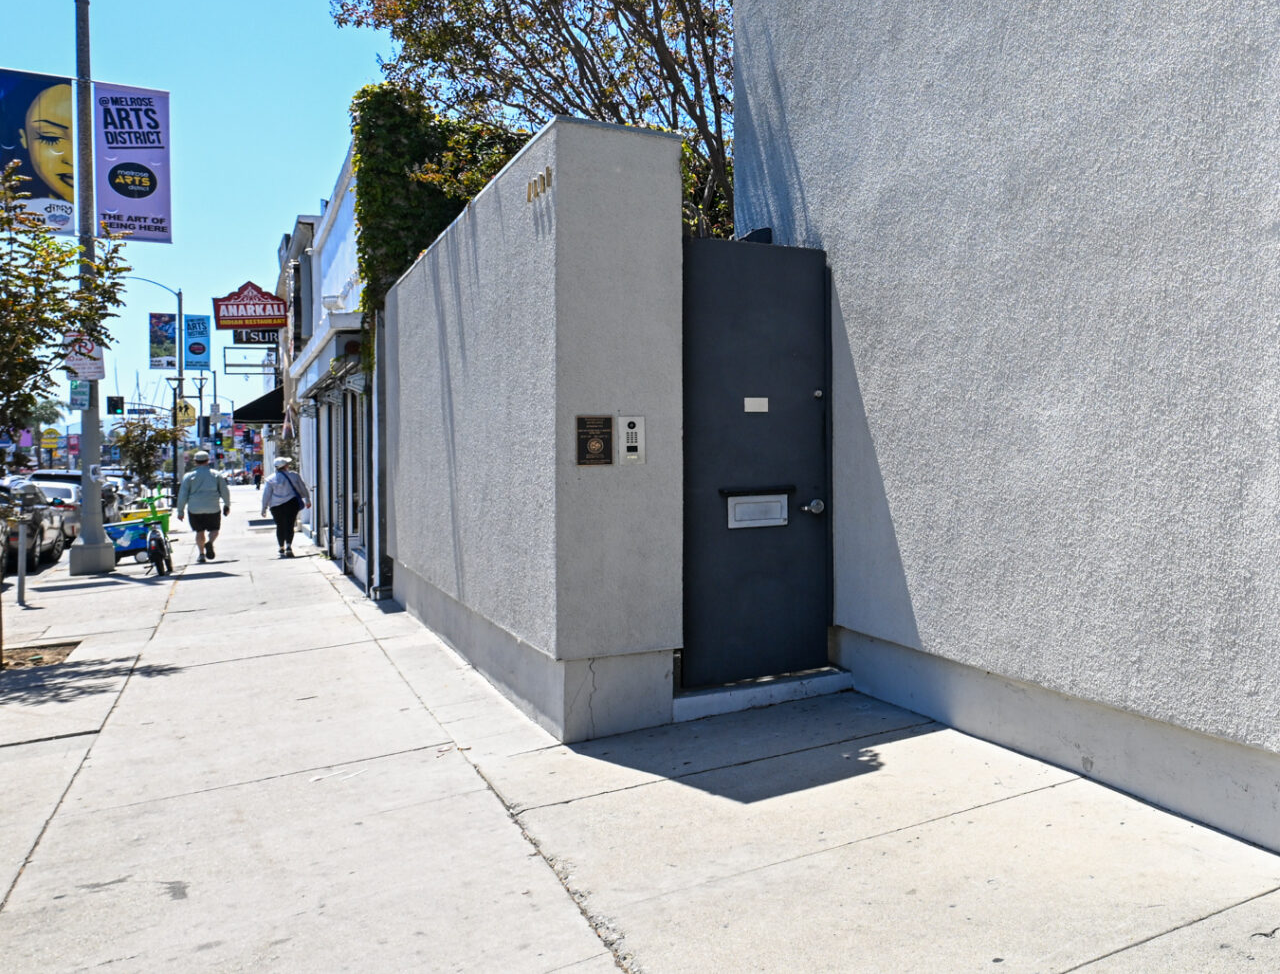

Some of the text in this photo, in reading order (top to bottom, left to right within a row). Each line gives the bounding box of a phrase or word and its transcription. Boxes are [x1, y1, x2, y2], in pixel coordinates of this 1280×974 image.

[98, 96, 154, 107] @MELROSE
[103, 108, 160, 130] ARTS
[105, 130, 162, 145] DISTRICT
[117, 169, 149, 178] melrose
[114, 176, 151, 186] ARTS
[101, 213, 124, 221] THE
[126, 215, 149, 223] ART
[139, 224, 168, 233] HERE
[219, 304, 285, 317] ANARKALI
[187, 321, 208, 331] ARTS
